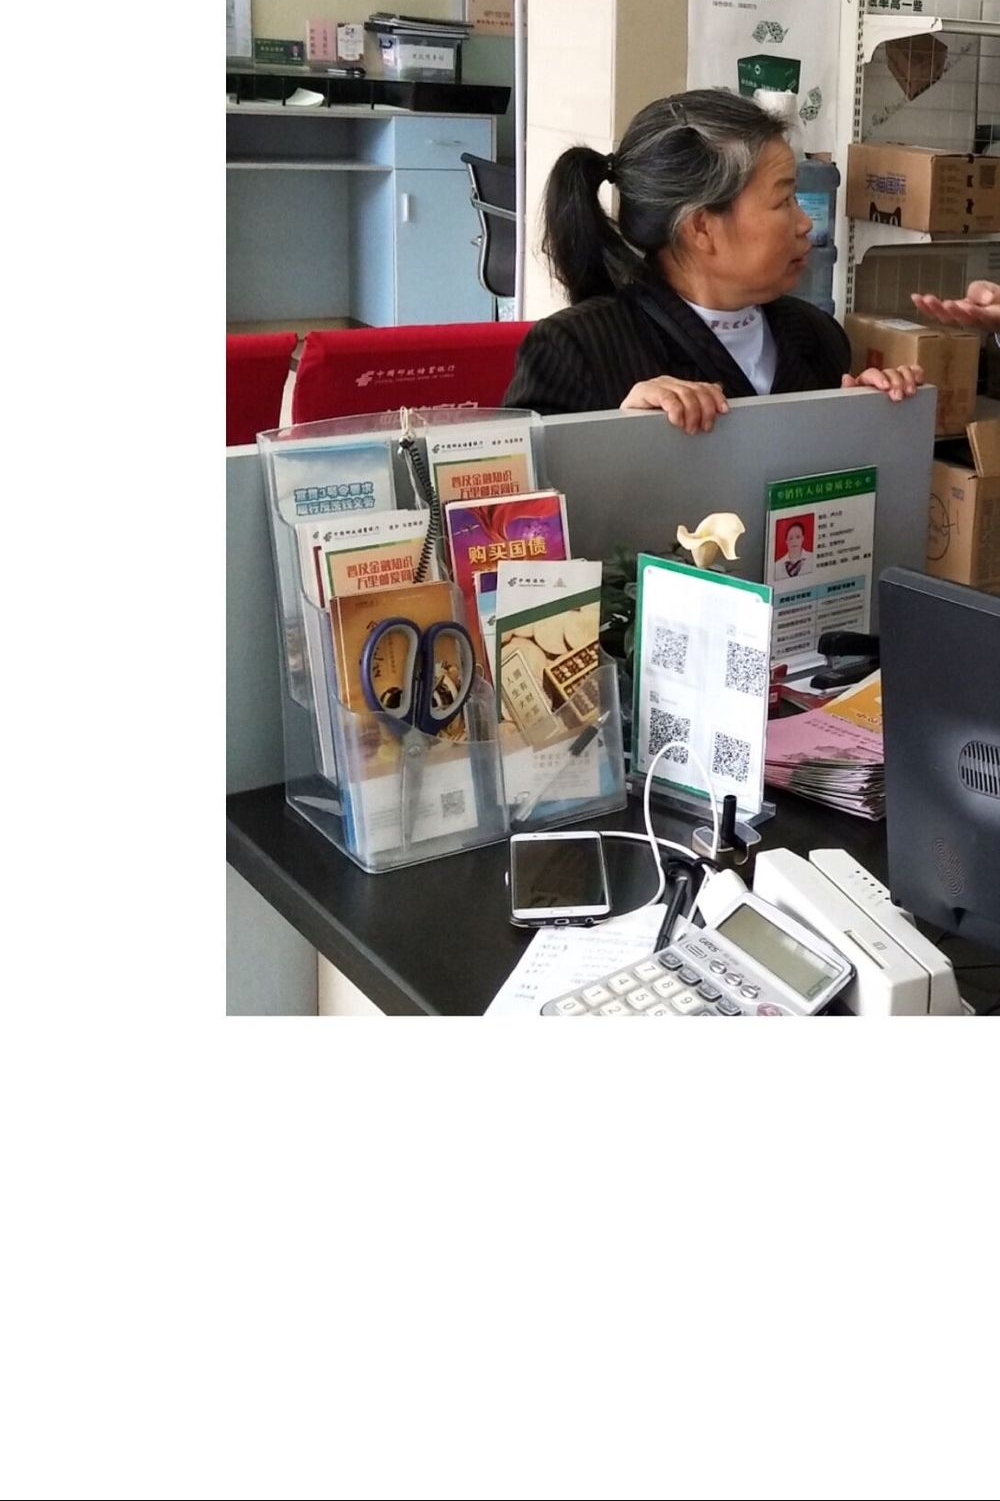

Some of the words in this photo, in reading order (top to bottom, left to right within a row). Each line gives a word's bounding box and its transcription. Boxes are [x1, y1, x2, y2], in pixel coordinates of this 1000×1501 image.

[866, 172, 907, 196] 天猫国际
[451, 470, 512, 488] 普及金融知识
[467, 536, 549, 564] 购买国债
[346, 555, 413, 578] 普及金融知识
